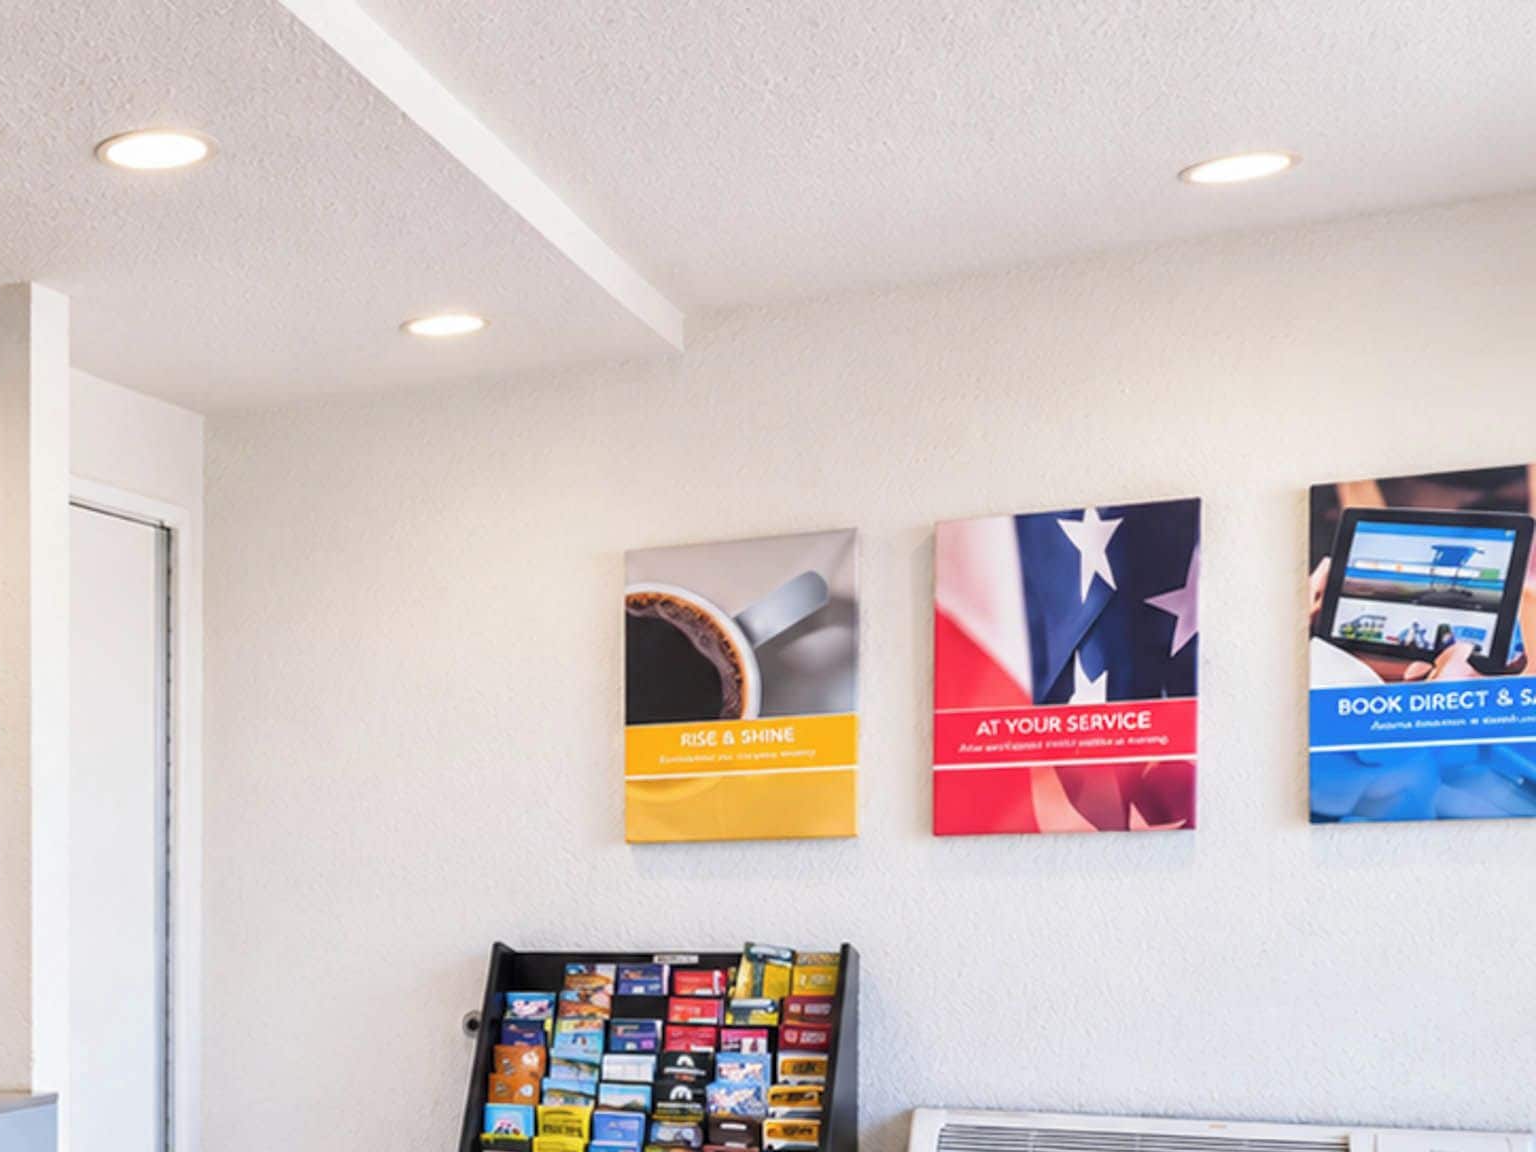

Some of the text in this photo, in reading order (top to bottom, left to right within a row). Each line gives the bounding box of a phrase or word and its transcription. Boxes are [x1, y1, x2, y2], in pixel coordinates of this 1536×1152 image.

[1338, 687, 1536, 716] BOOK DIRECT & S
[976, 710, 1152, 736] AT YOUR SERVICE
[680, 726, 796, 747] RISE & SHINE
